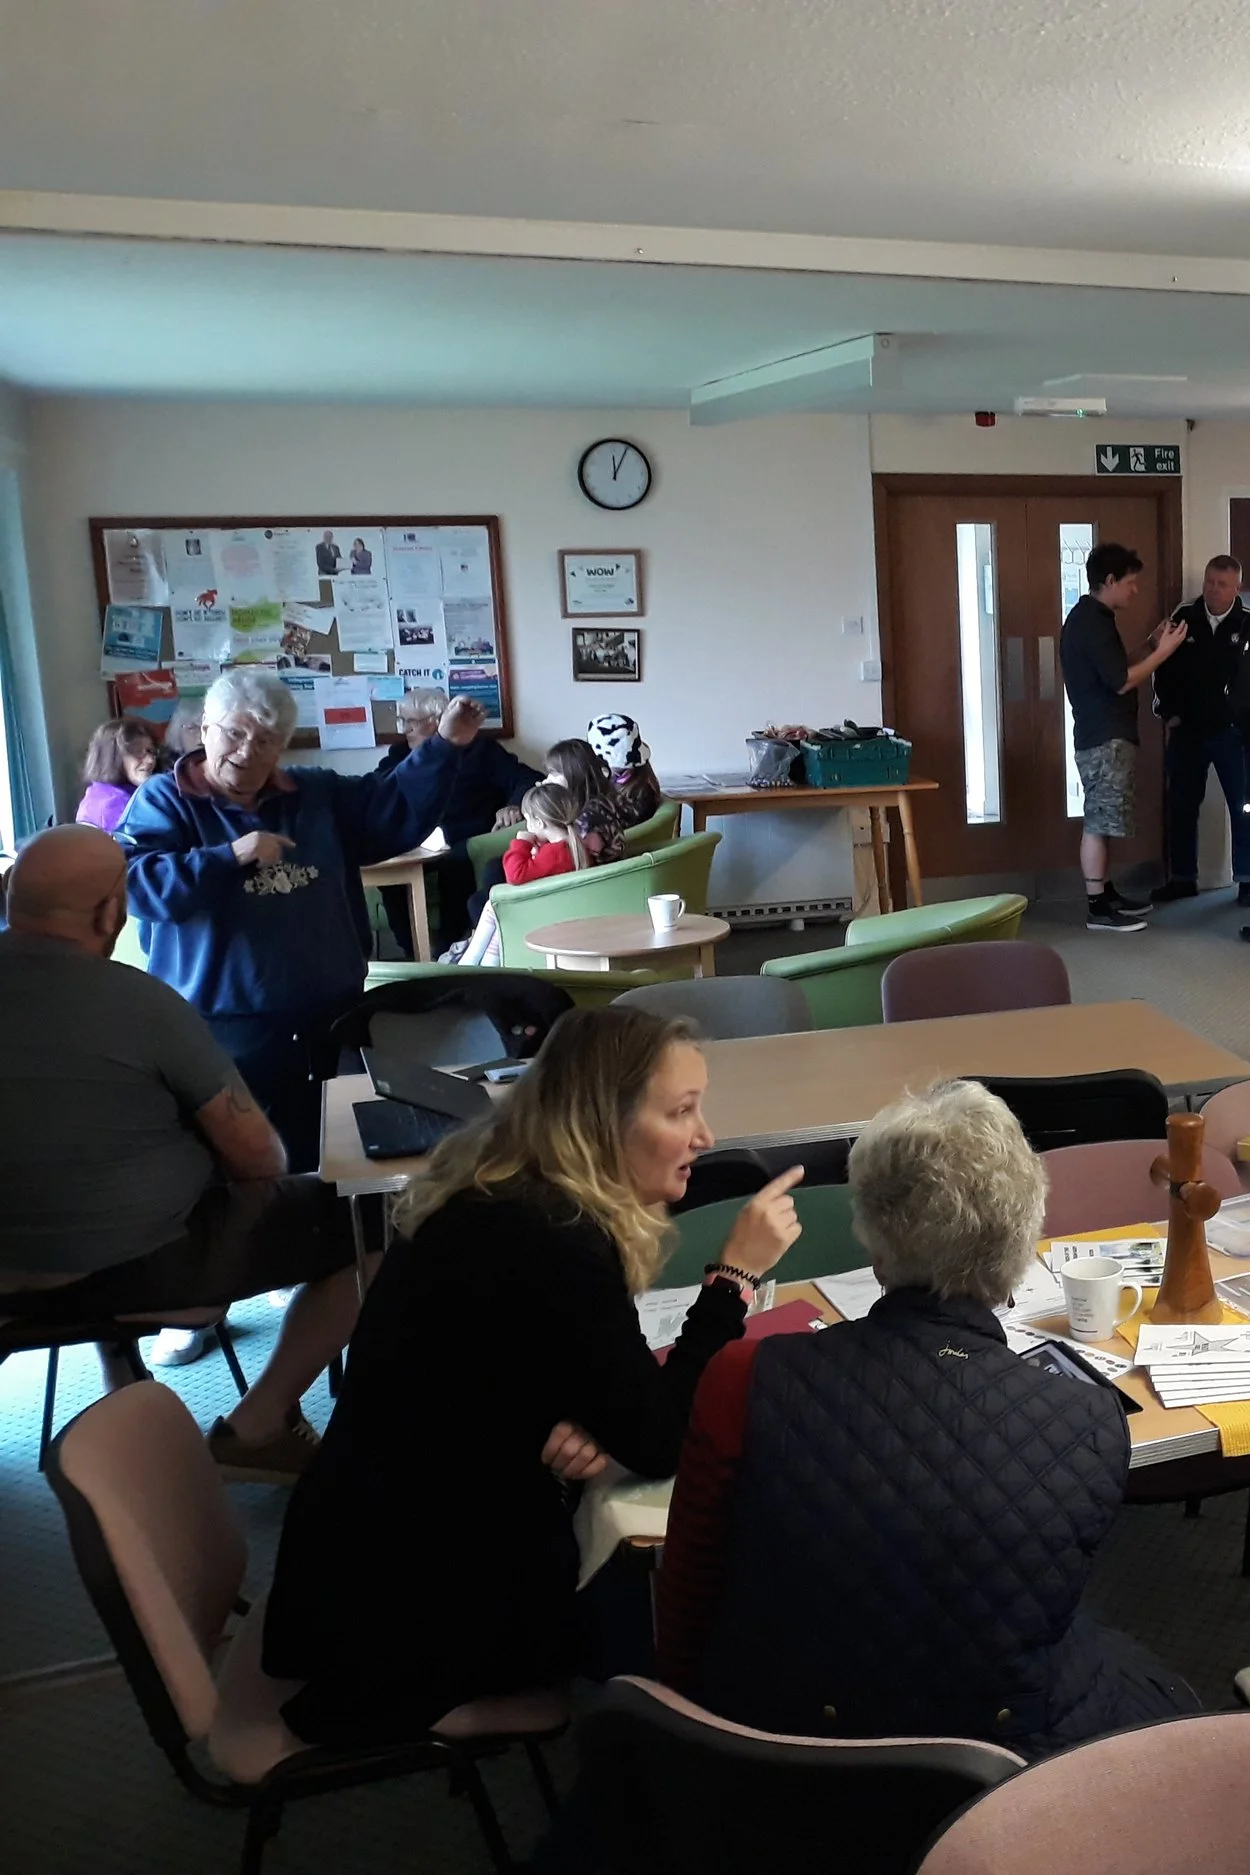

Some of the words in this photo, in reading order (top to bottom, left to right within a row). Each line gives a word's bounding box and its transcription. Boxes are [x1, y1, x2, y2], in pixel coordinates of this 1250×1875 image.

[1154, 447, 1175, 459] Fire
[1156, 460, 1175, 471] exit
[586, 567, 614, 577] WOW
[399, 668, 422, 677] CATCH
[423, 668, 431, 677] IT
